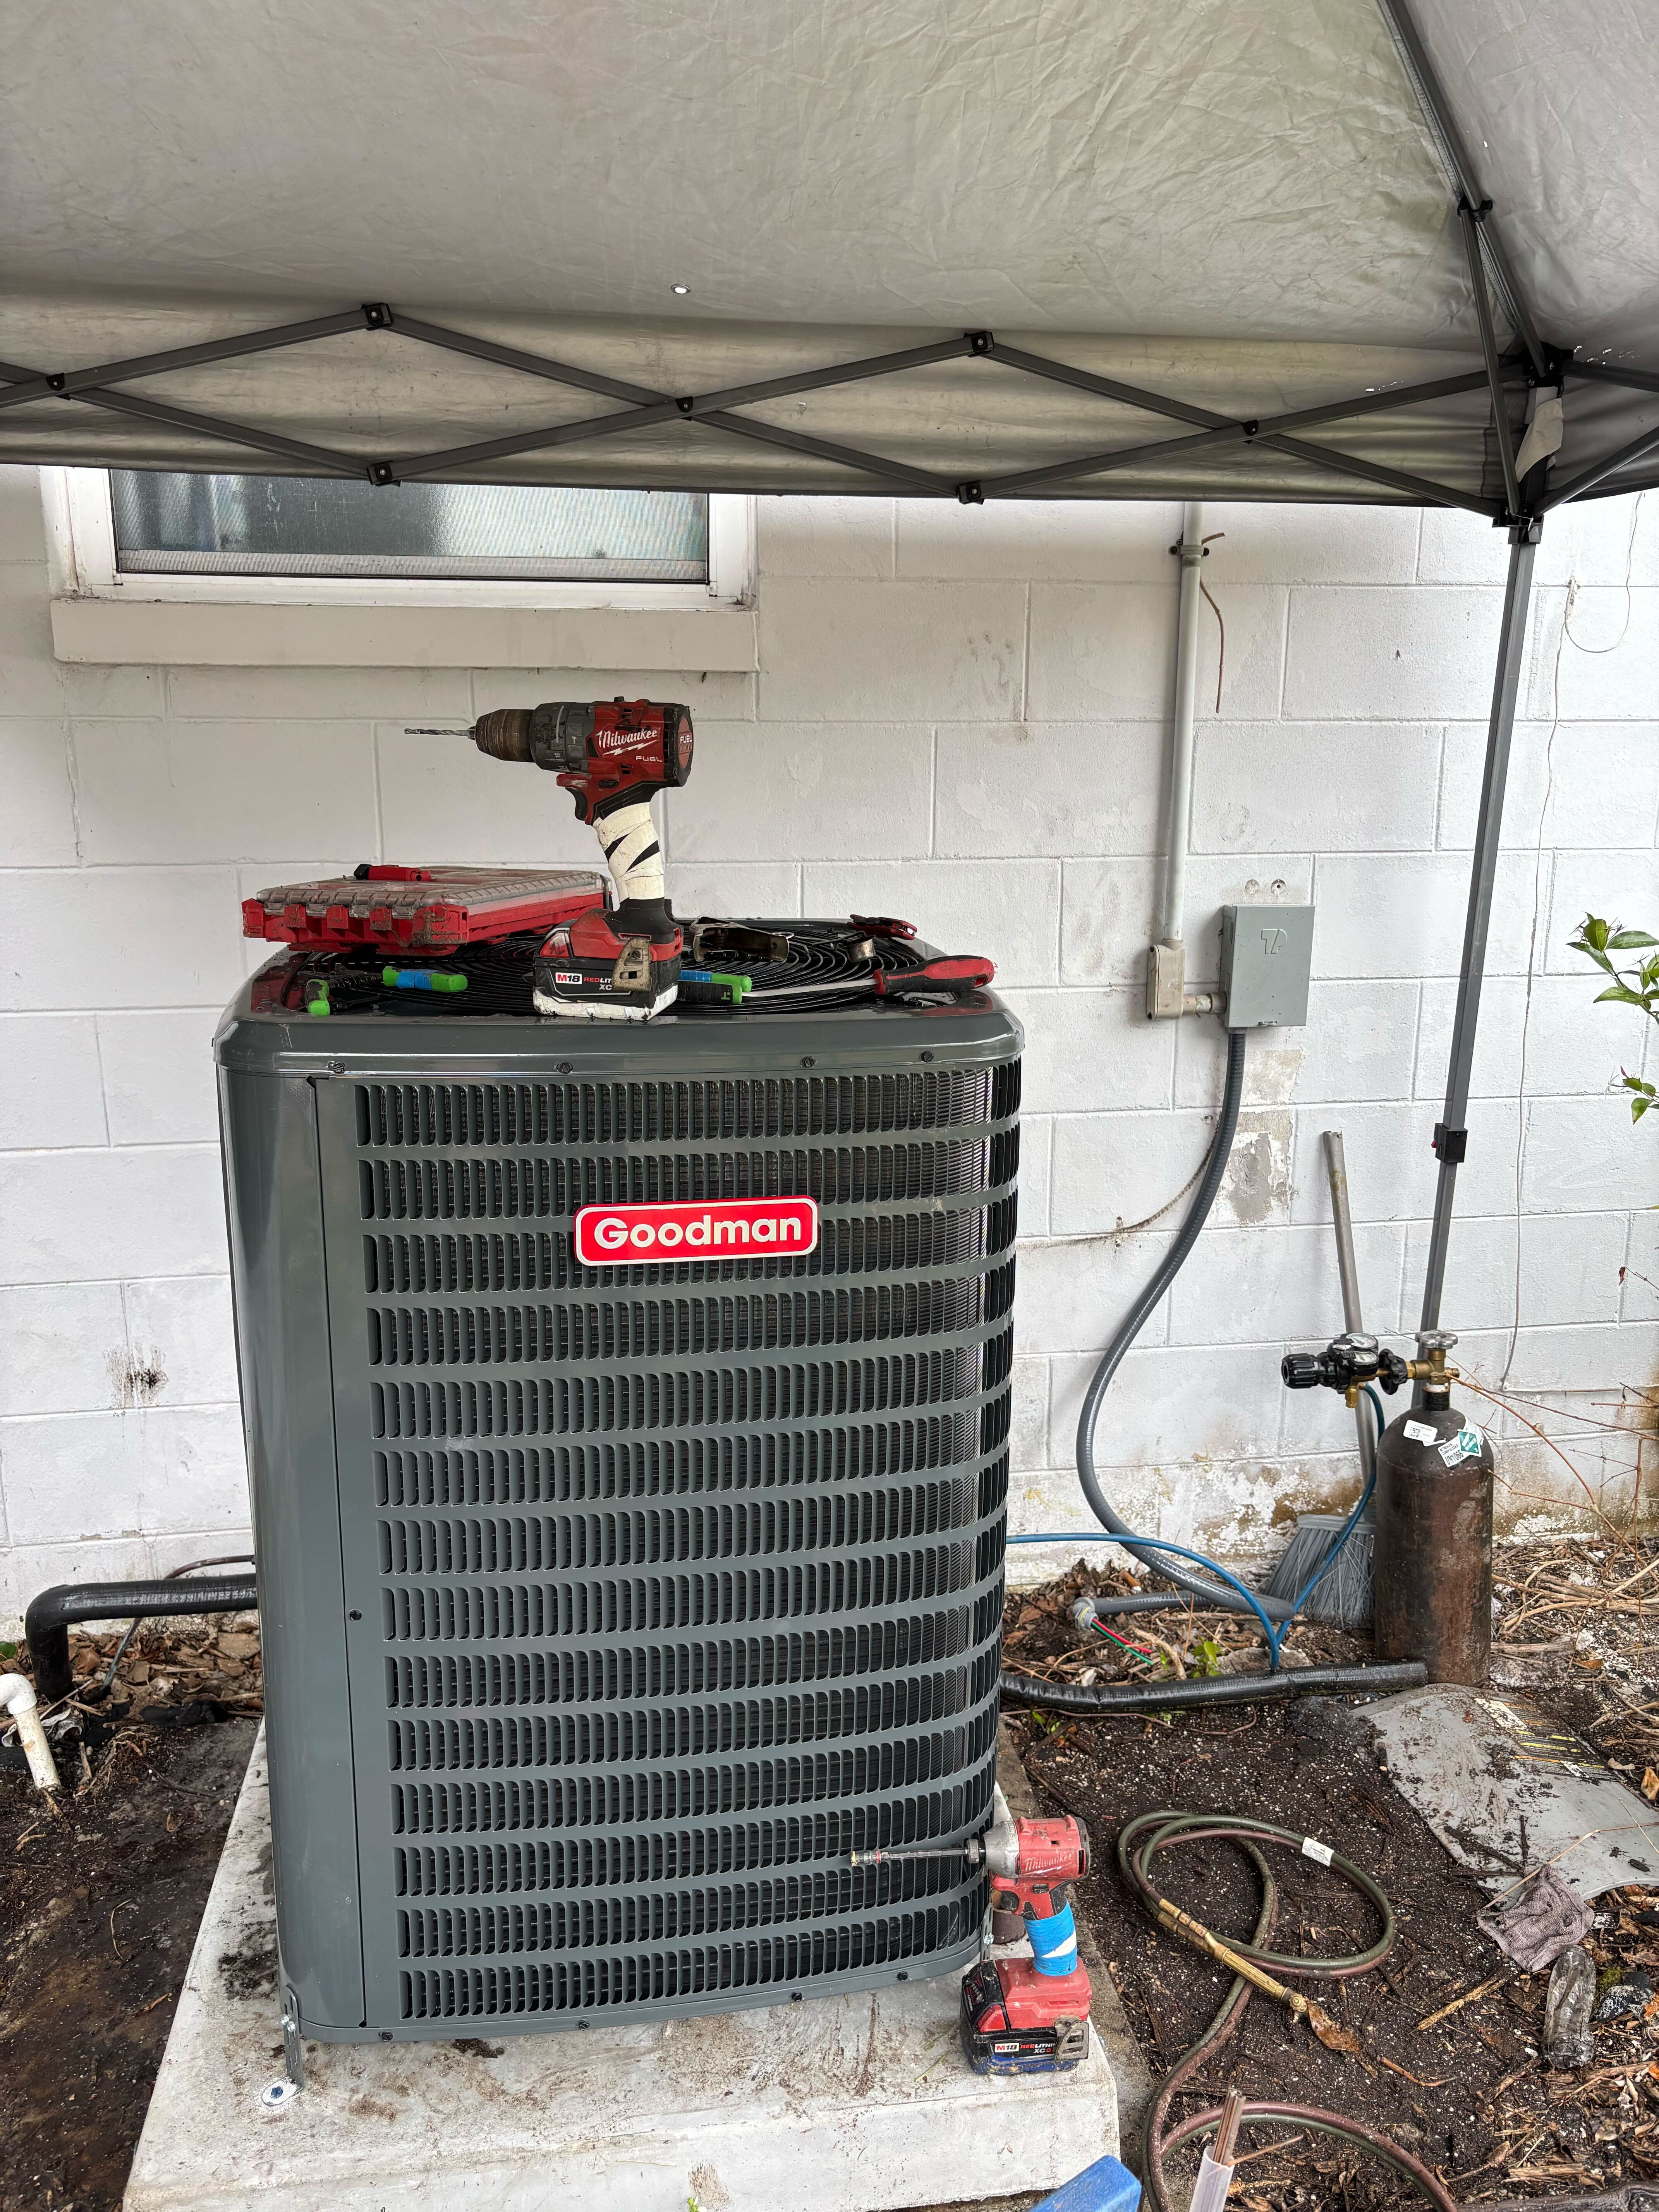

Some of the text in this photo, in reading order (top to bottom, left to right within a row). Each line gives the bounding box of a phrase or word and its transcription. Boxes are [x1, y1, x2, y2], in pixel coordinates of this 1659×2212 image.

[596, 728, 658, 749] Milwaukee
[680, 735, 692, 744] FUEL
[594, 1215, 801, 1249] Goodman
